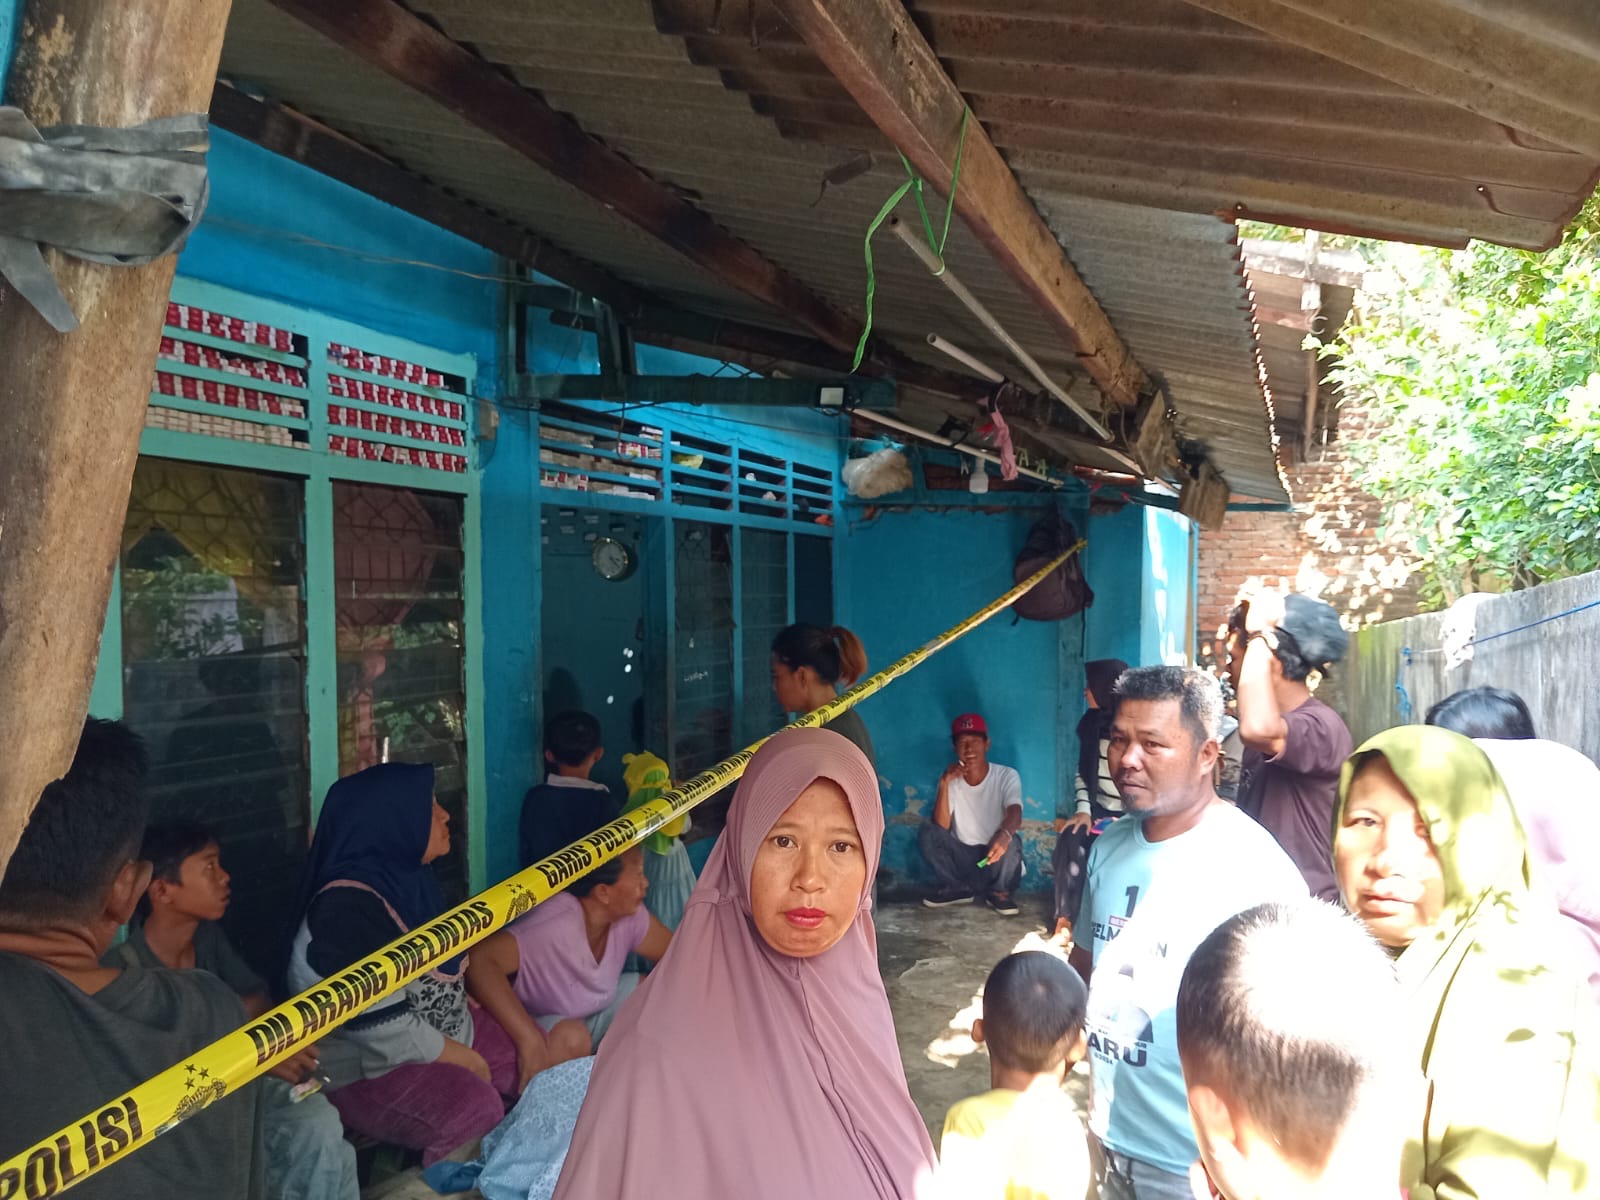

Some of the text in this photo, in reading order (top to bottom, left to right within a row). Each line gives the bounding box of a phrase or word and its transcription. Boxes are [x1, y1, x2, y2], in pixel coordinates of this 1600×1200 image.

[245, 961, 388, 1067] DILARANG
[384, 901, 494, 983] MELINTAS
[536, 845, 592, 888] GARIS
[583, 818, 637, 859] POLISI
[1087, 1032, 1147, 1067] ARU
